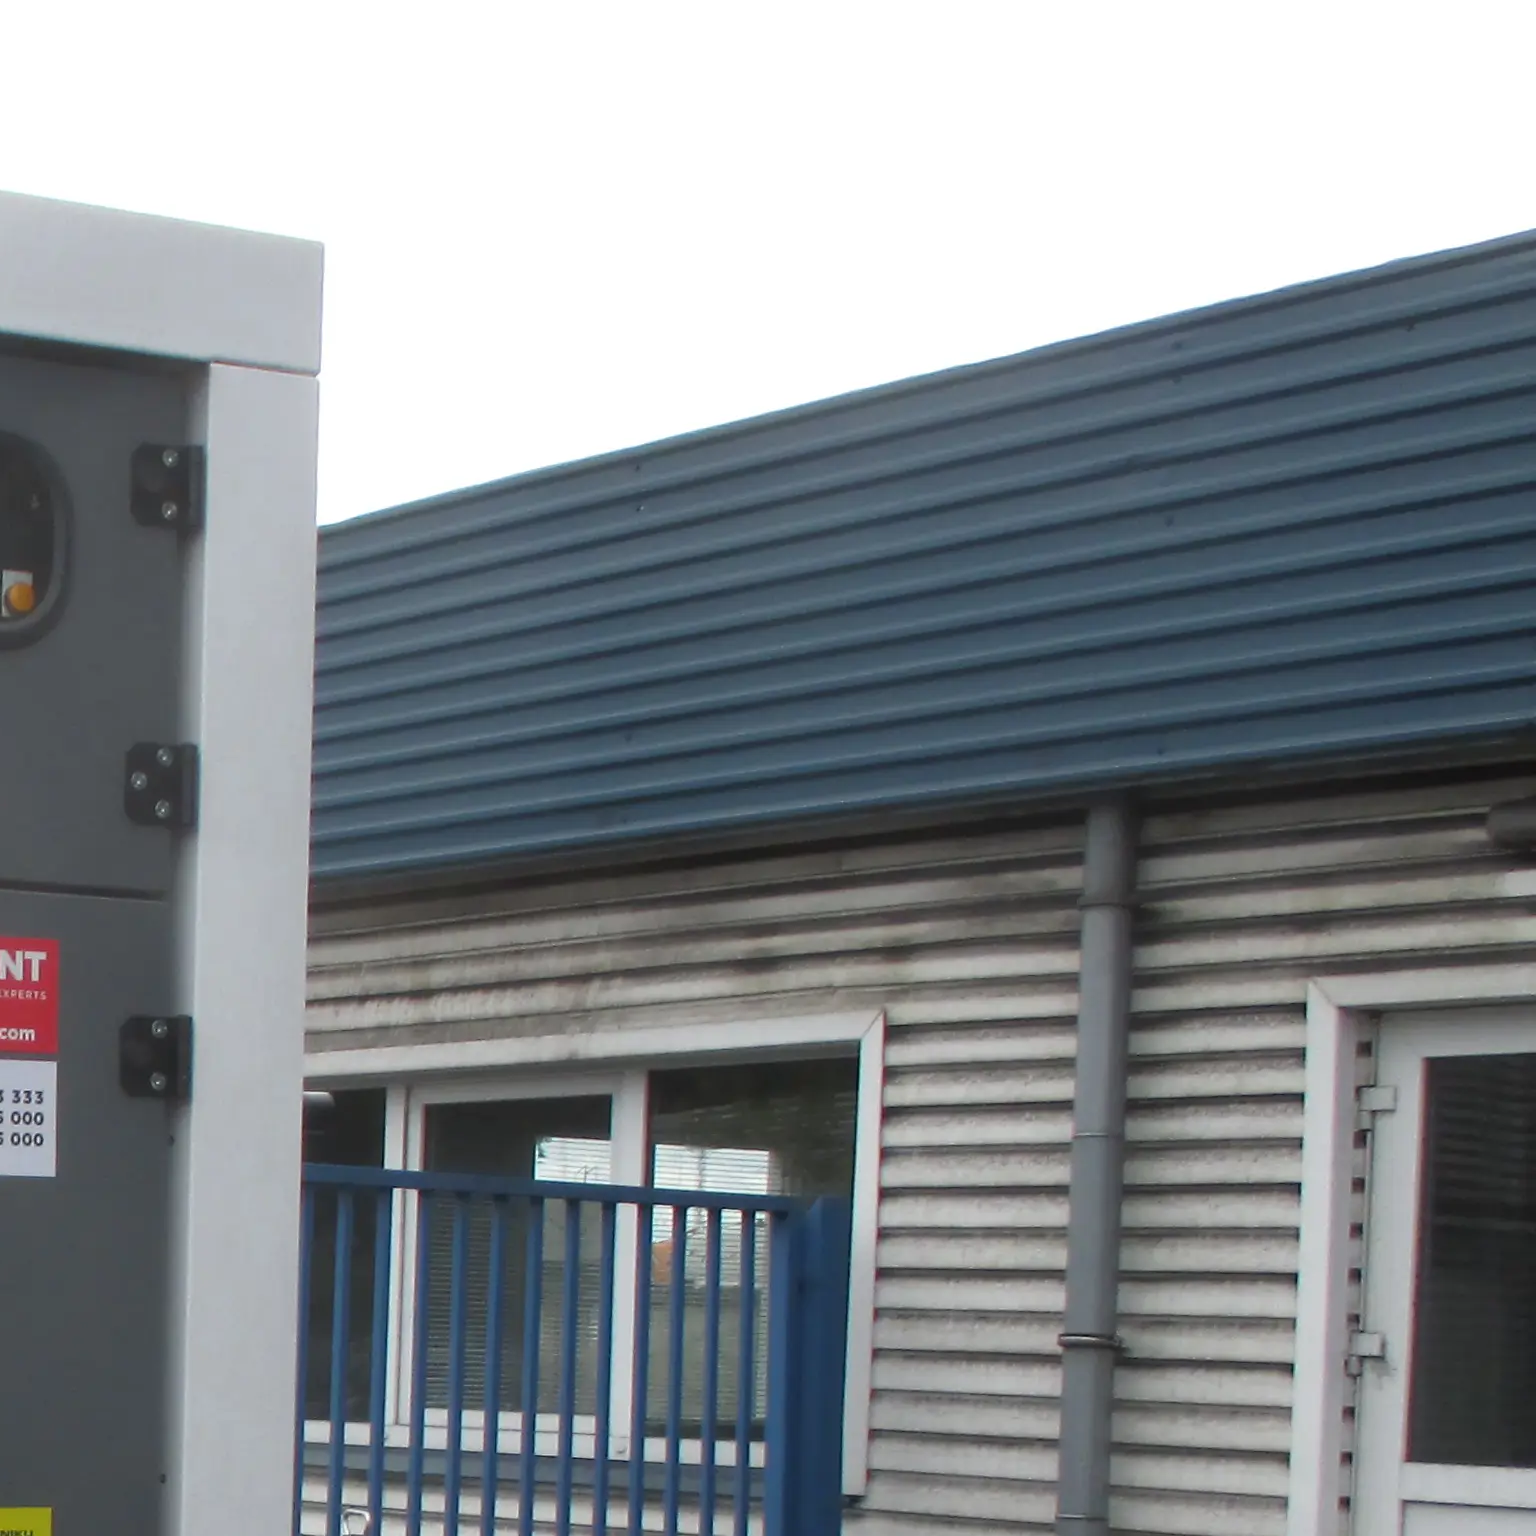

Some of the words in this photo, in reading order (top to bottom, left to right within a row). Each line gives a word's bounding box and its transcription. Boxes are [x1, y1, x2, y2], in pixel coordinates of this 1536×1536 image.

[12, 1090, 44, 1105] 333
[10, 1111, 44, 1126] 000
[10, 1132, 44, 1147] 000
